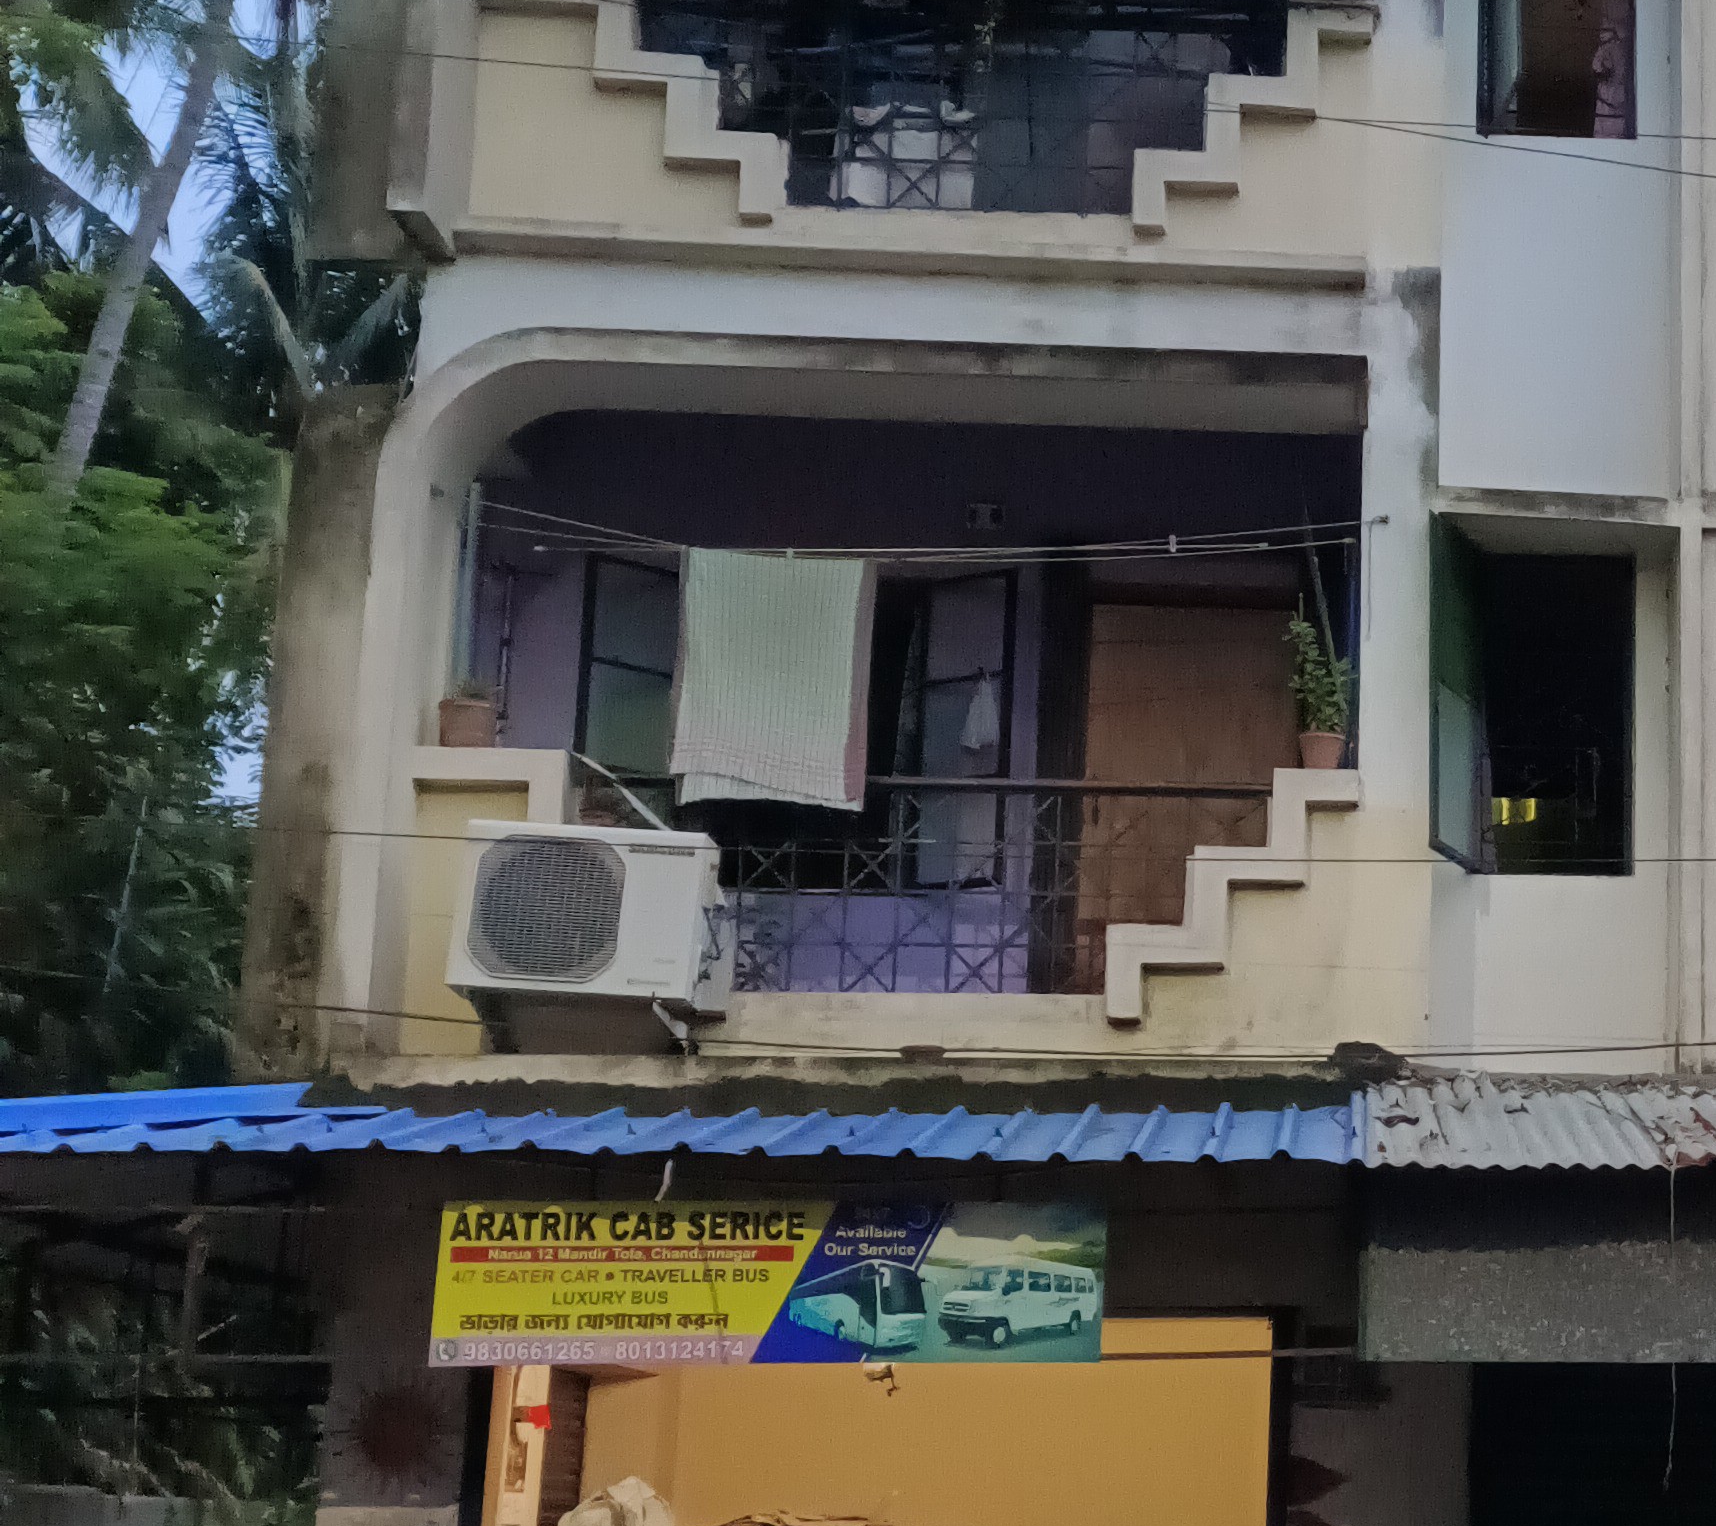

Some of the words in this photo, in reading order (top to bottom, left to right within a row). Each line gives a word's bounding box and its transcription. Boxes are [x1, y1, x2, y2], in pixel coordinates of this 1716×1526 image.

[450, 1210, 598, 1241] ARATRIK
[609, 1210, 676, 1241] CAB
[687, 1210, 806, 1241] SERICE
[835, 1226, 907, 1239] Available
[537, 1249, 554, 1260] 12
[558, 1248, 607, 1260] Mandir
[824, 1243, 854, 1256] Our
[858, 1243, 916, 1256] Service
[482, 1270, 554, 1284] SEATER
[561, 1270, 599, 1283] CAR
[620, 1269, 727, 1283] TRAVELLER
[732, 1269, 770, 1283] BUS
[552, 1291, 626, 1305] LUXURY
[631, 1291, 669, 1305] BUS
[524, 1313, 572, 1331] জন্য
[576, 1312, 672, 1331] যোগাযোগ
[676, 1312, 730, 1332] করুন
[463, 1341, 596, 1361] 9830661265
[614, 1340, 745, 1360] 8013124174
